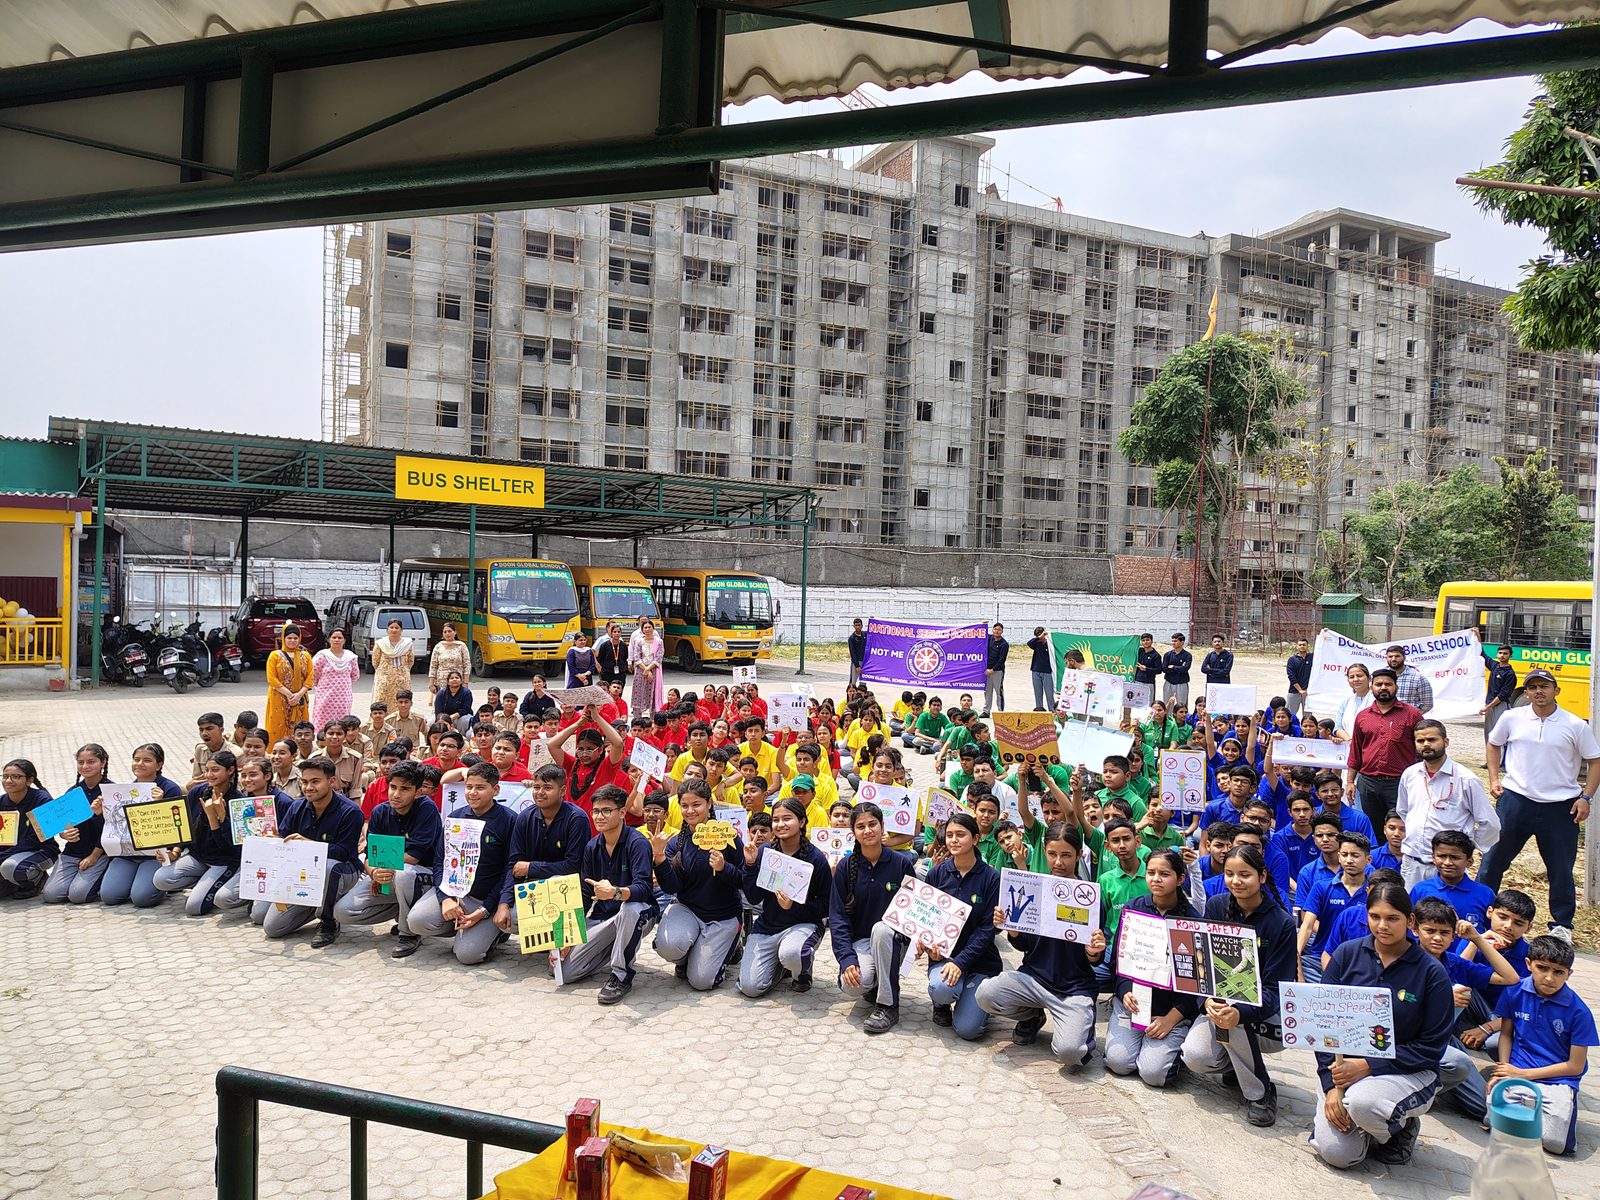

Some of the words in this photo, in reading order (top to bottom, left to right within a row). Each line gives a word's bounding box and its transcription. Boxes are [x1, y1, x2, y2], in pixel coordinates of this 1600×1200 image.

[408, 470, 447, 488] BUS
[453, 474, 534, 494] SHELTER
[544, 571, 568, 579] SCHOOL
[869, 623, 915, 638] NATIONAL
[915, 629, 949, 638] SERVICE
[950, 628, 986, 638] SCHEME
[1427, 636, 1471, 652] SCHOOL
[870, 648, 889, 656] NOT
[891, 650, 904, 658] ME
[1094, 653, 1122, 663] DOON
[1522, 649, 1561, 662] DOON
[1566, 652, 1592, 664] GLO
[1096, 663, 1135, 674] GLOBA
[1323, 664, 1342, 672] NOT
[1435, 669, 1450, 678] BUT
[1451, 668, 1468, 676] YOU
[466, 855, 479, 865] DIE
[1329, 898, 1345, 906] HOPE
[1176, 919, 1200, 930] ROAD
[1207, 922, 1242, 935] SAFETY
[1213, 948, 1240, 957] WALK
